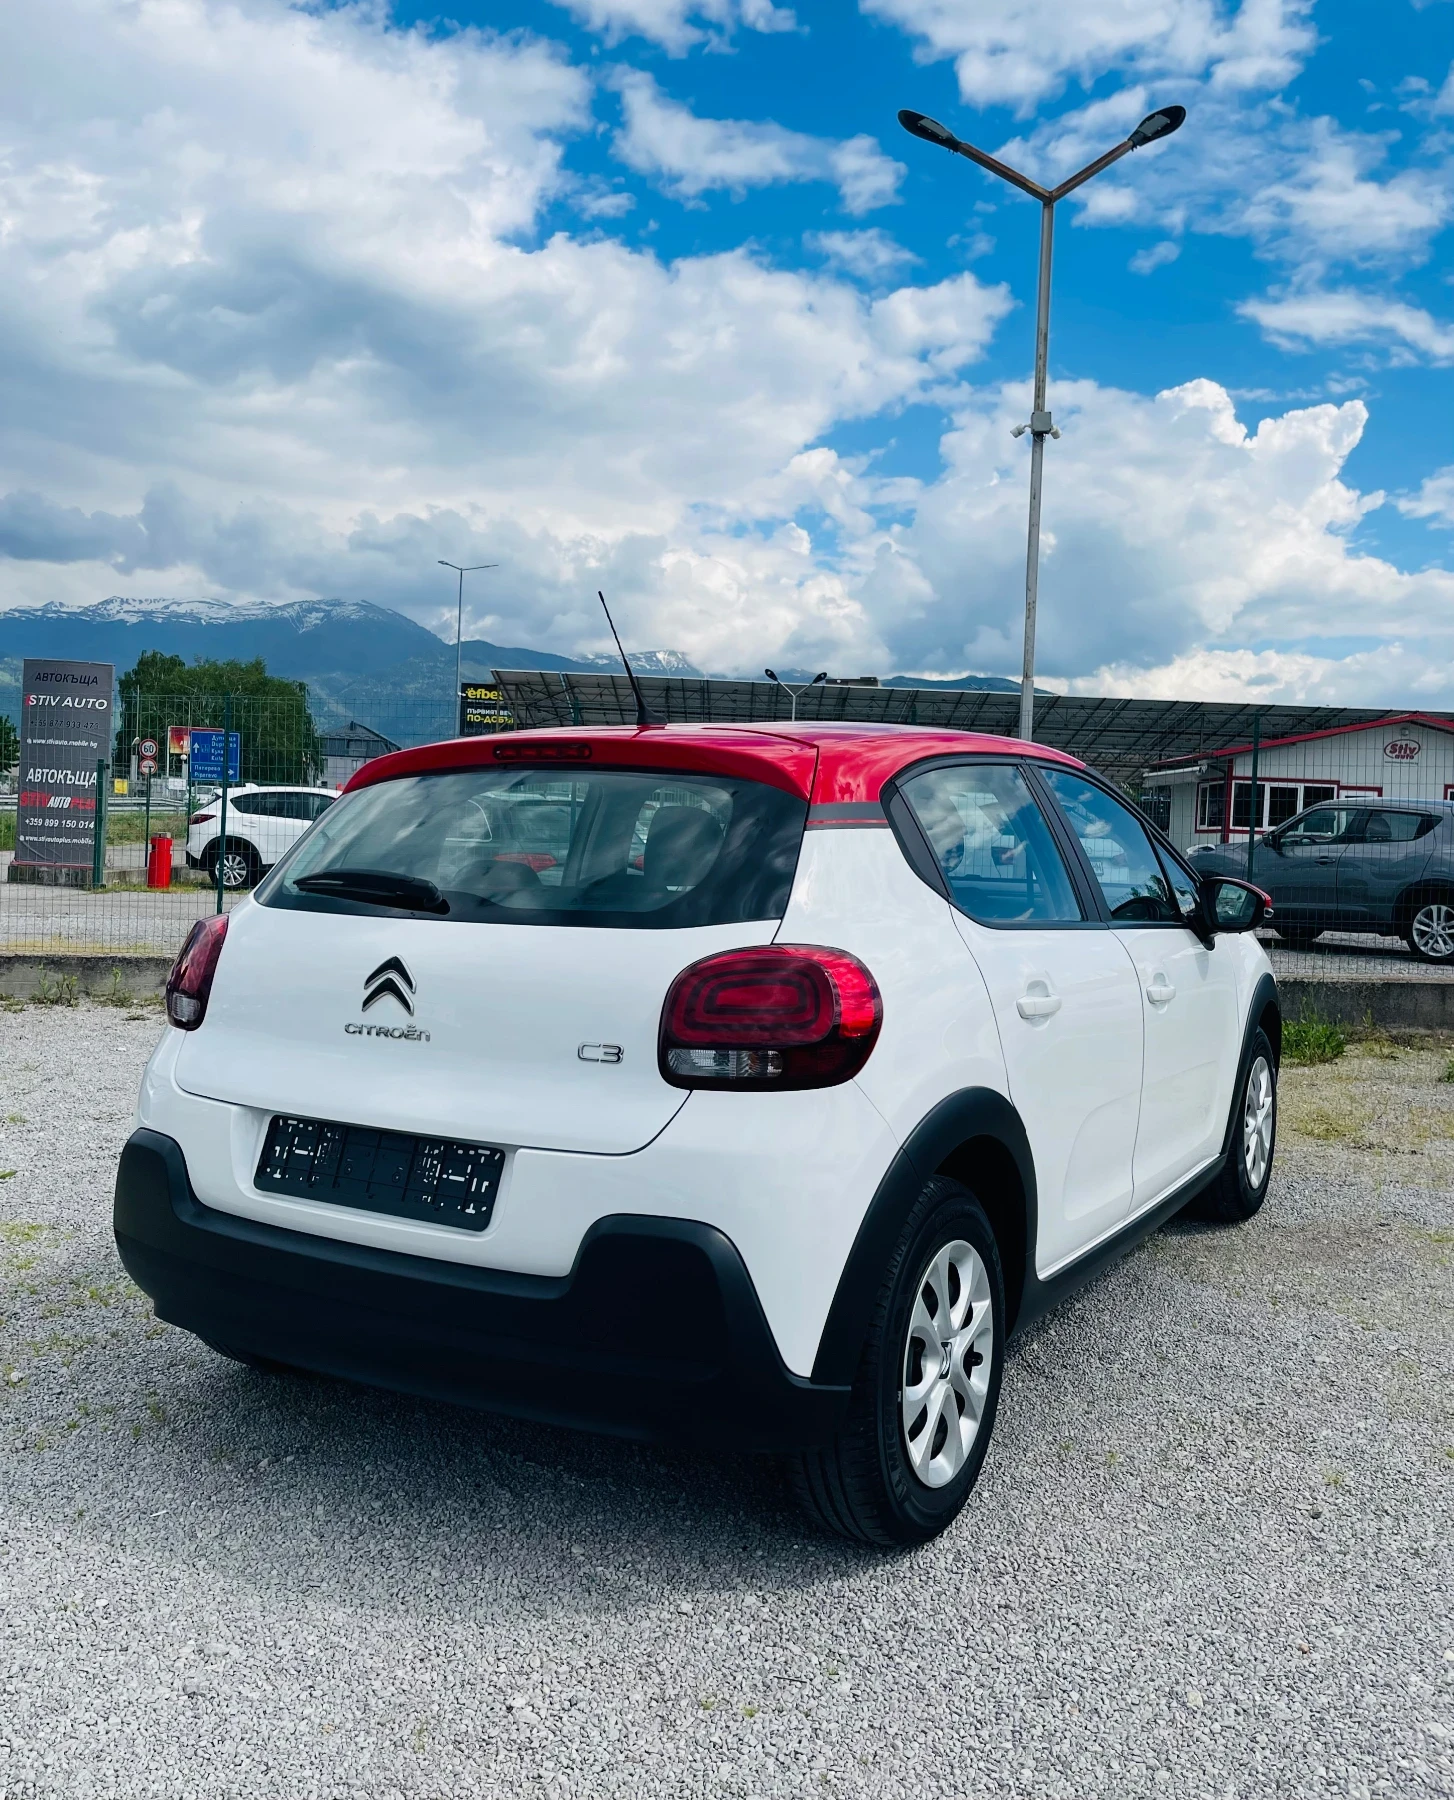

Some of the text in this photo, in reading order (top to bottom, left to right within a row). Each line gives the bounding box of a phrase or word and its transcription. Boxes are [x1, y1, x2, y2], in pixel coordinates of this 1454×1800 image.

[34, 672, 98, 686] АВТОКЪЩА
[28, 694, 108, 710] STIV AUTO
[66, 721, 81, 729] 933
[143, 744, 154, 753] 60
[1389, 743, 1417, 754] Stiv
[26, 767, 97, 788] АВТОКЪЩА
[24, 817, 95, 829] +359 899 150 014
[344, 1022, 431, 1042] CITROËN
[577, 1041, 625, 1064] C3
